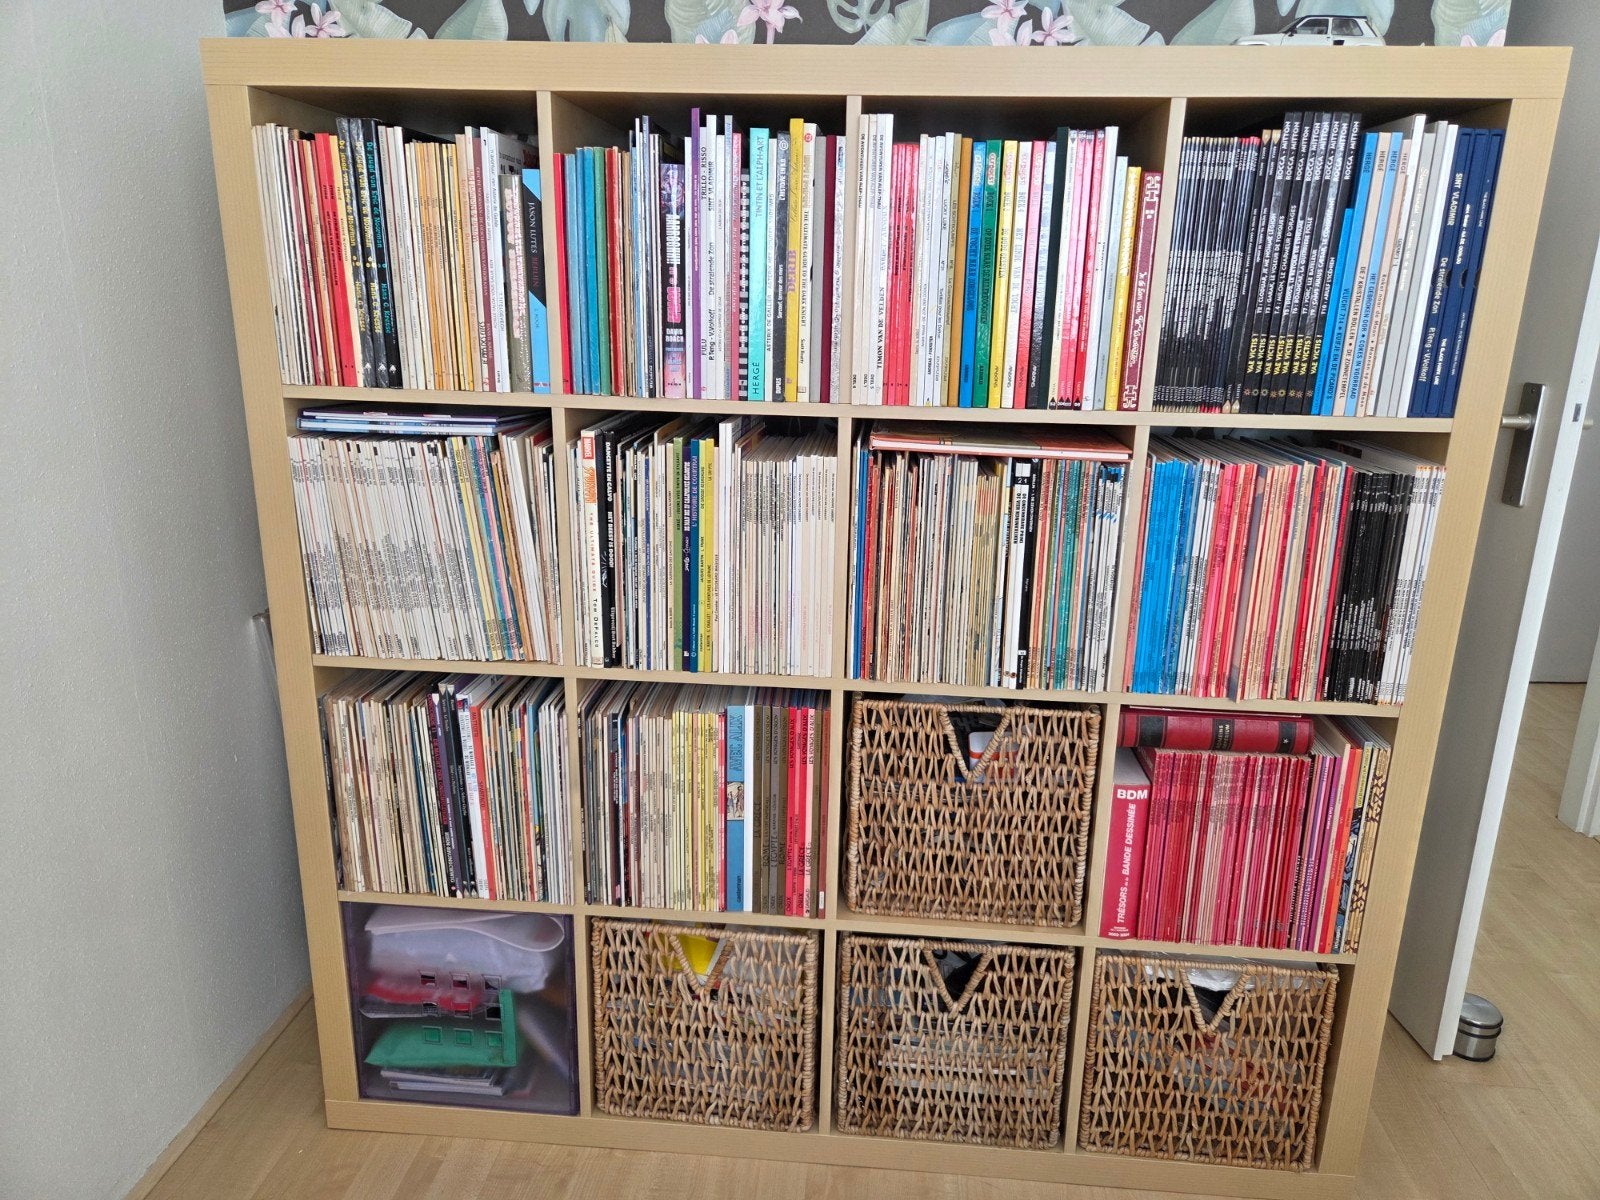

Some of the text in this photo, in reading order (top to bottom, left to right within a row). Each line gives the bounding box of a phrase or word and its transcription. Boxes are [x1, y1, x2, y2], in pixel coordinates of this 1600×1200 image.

[1300, 127, 1309, 153] MITTON
[1319, 122, 1329, 150] MITTON
[756, 136, 764, 180] L'ALPH-ART
[1295, 158, 1304, 180] ROCCA
[1314, 156, 1323, 180] ROCCA
[1362, 152, 1372, 173] HERGÉ
[1376, 150, 1386, 172] HERGÉ
[1388, 150, 1398, 172] HERGÉ
[1399, 153, 1408, 174] HERGÉ
[756, 182, 763, 191] ET
[1453, 173, 1463, 188] SINT
[527, 202, 536, 227] JASON
[1446, 191, 1459, 226] VLADIMIR
[1286, 205, 1296, 236] D'ORAGES
[1246, 121, 1291, 373] VAE VICTIS ROCCA MITTON
[1257, 338, 1266, 359] VICTIS
[1284, 156, 1294, 180] ROCCA
[1289, 122, 1300, 150] MITTON
[1272, 123, 1321, 375] VAE VICTIS ROCCA MITTON
[1291, 121, 1339, 374] VAE VICTIS ROCCA MITTON
[1302, 341, 1311, 360] VICTIS
[1332, 158, 1342, 182] ROCCA
[1337, 123, 1348, 151] MITTON
[1312, 340, 1321, 359] VICTIS
[1343, 155, 1353, 180] ROCCA
[1349, 121, 1359, 149] MITTON
[1280, 237, 1291, 270] CHARMEUR
[1440, 257, 1448, 266] De
[802, 268, 808, 277] TO
[1359, 266, 1366, 275] DE
[708, 287, 714, 296] De
[1434, 268, 1446, 299] stralende
[1339, 288, 1349, 312] VLUCHT
[1352, 281, 1364, 316] KRISTALLEN
[1363, 286, 1374, 318] GEBROKEN
[1431, 300, 1440, 314] Zon
[878, 319, 883, 328] DE
[1348, 317, 1358, 340] BOLLEN
[1360, 319, 1368, 332] OOR
[1266, 340, 1276, 360] VICTIS
[1283, 339, 1293, 359] VICTIS
[1333, 332, 1342, 352] KUIFJE
[1356, 340, 1365, 359] COKES
[1263, 362, 1272, 375] VAE
[1281, 361, 1289, 374] VAE
[1338, 358, 1351, 399] ZONNETEMPEL
[1348, 368, 1360, 399] VOORRAAD
[583, 438, 592, 458] MARVEL
[606, 473, 612, 481] EN
[728, 714, 742, 741] ALIX
[1117, 789, 1148, 800] BDM
[1117, 803, 1136, 924] TRÉSORS BANDE DESSINÉE
